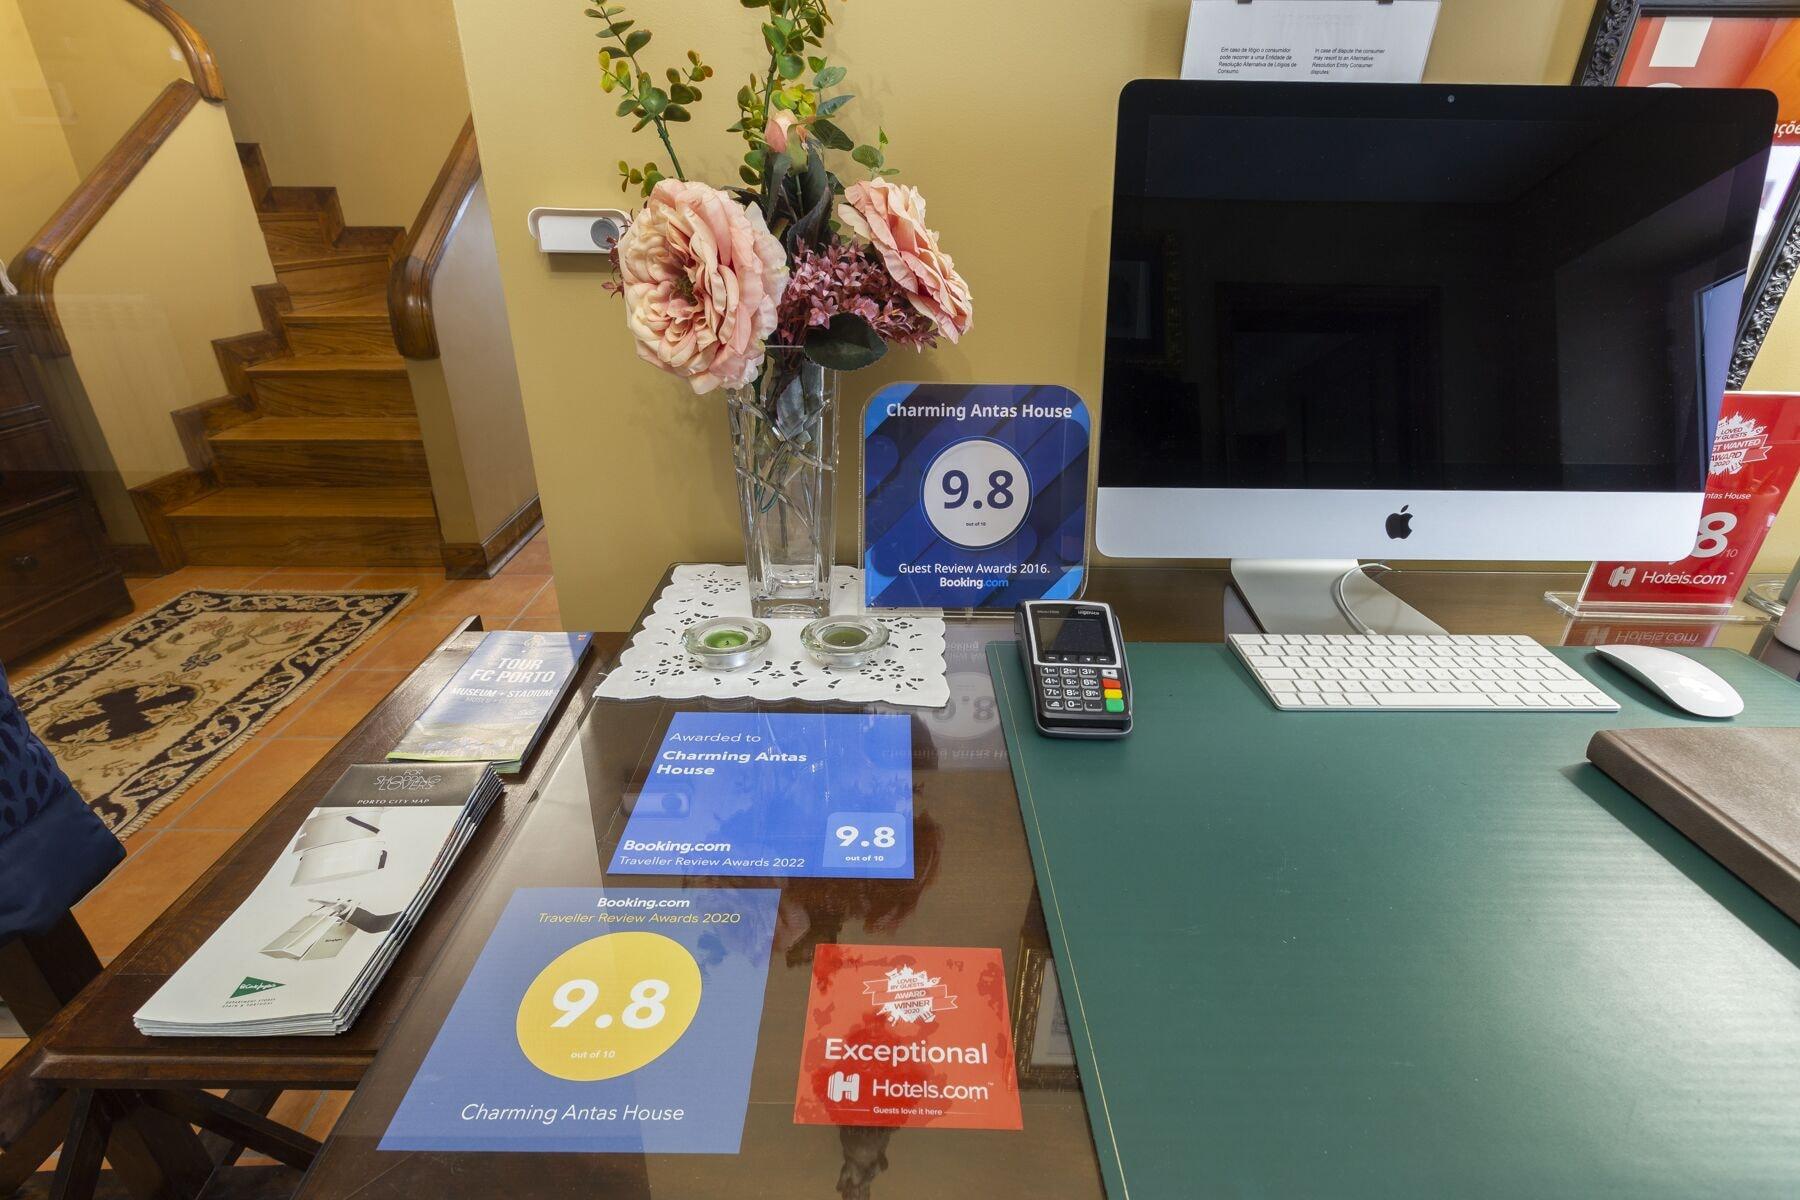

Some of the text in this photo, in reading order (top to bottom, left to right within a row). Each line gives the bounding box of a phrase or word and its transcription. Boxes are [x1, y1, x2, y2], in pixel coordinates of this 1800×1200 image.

[886, 403, 1072, 421] Charming Antas House
[1721, 427, 1743, 435] LOVED
[1722, 432, 1747, 440] GUESTS
[1712, 439, 1760, 452] ST WANTED
[941, 470, 1014, 510] 9.8
[1725, 492, 1752, 500] House
[899, 563, 1050, 574] Guest Review Awards 2016.
[940, 577, 1008, 589] Booking.com
[499, 658, 543, 670] TOUR
[469, 669, 556, 683] FC PORTO
[452, 688, 498, 697] MUSEUM
[507, 689, 553, 697] STADIUM
[669, 732, 761, 743] Awarded to
[662, 750, 807, 764] Charming Antas
[656, 764, 715, 776] House
[835, 825, 896, 848] 9.8
[623, 840, 731, 854] Booking.com
[619, 856, 805, 868] Traveller Review Awards 2022
[862, 854, 871, 862] of
[597, 897, 690, 910] Booking.com
[538, 912, 740, 924] Traveller Review Awards 2020
[895, 990, 926, 999] AWARD
[550, 979, 670, 1030] 9.8
[894, 1000, 930, 1009] WINNER
[570, 1050, 615, 1059] out of 10
[824, 1038, 988, 1066] Exceptional
[873, 1079, 988, 1099] Hotels.com
[461, 1104, 684, 1125] Charming Antas House
[873, 1107, 942, 1116] Guests love it here
